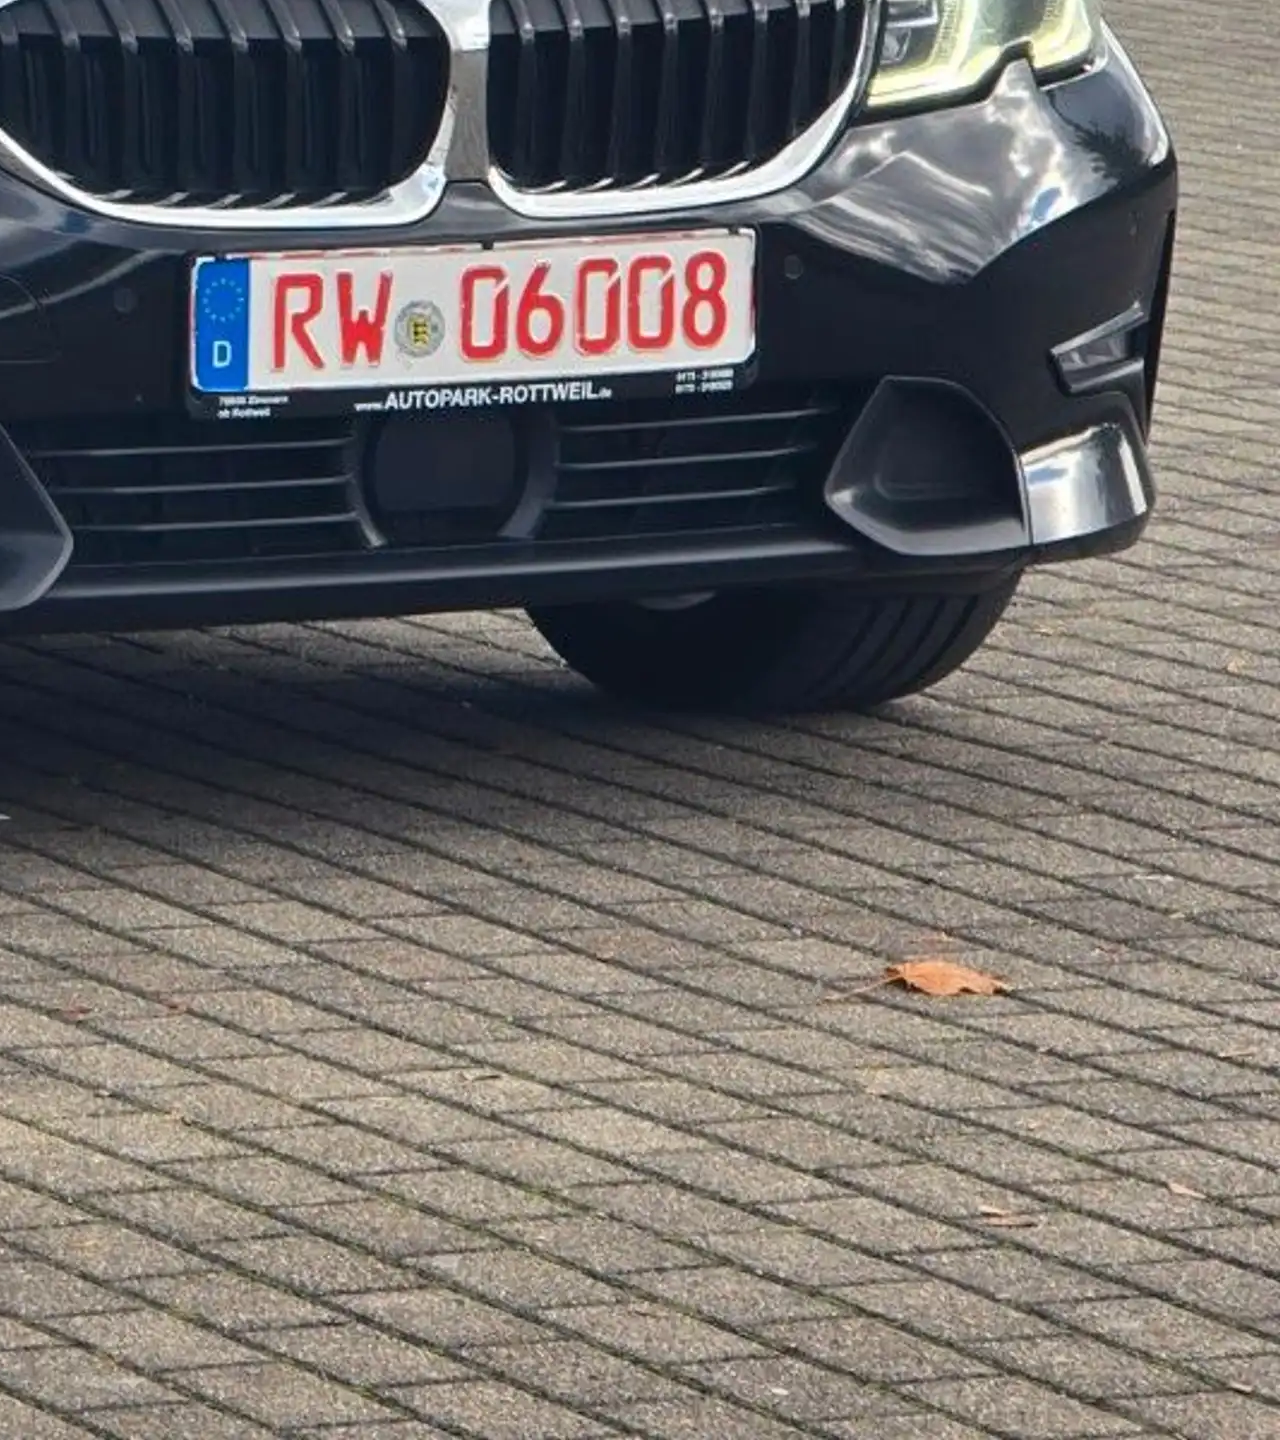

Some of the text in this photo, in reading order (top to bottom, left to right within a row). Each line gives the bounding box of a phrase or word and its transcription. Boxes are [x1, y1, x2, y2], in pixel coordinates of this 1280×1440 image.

[269, 250, 727, 372] RW 06008
[213, 341, 233, 369] D
